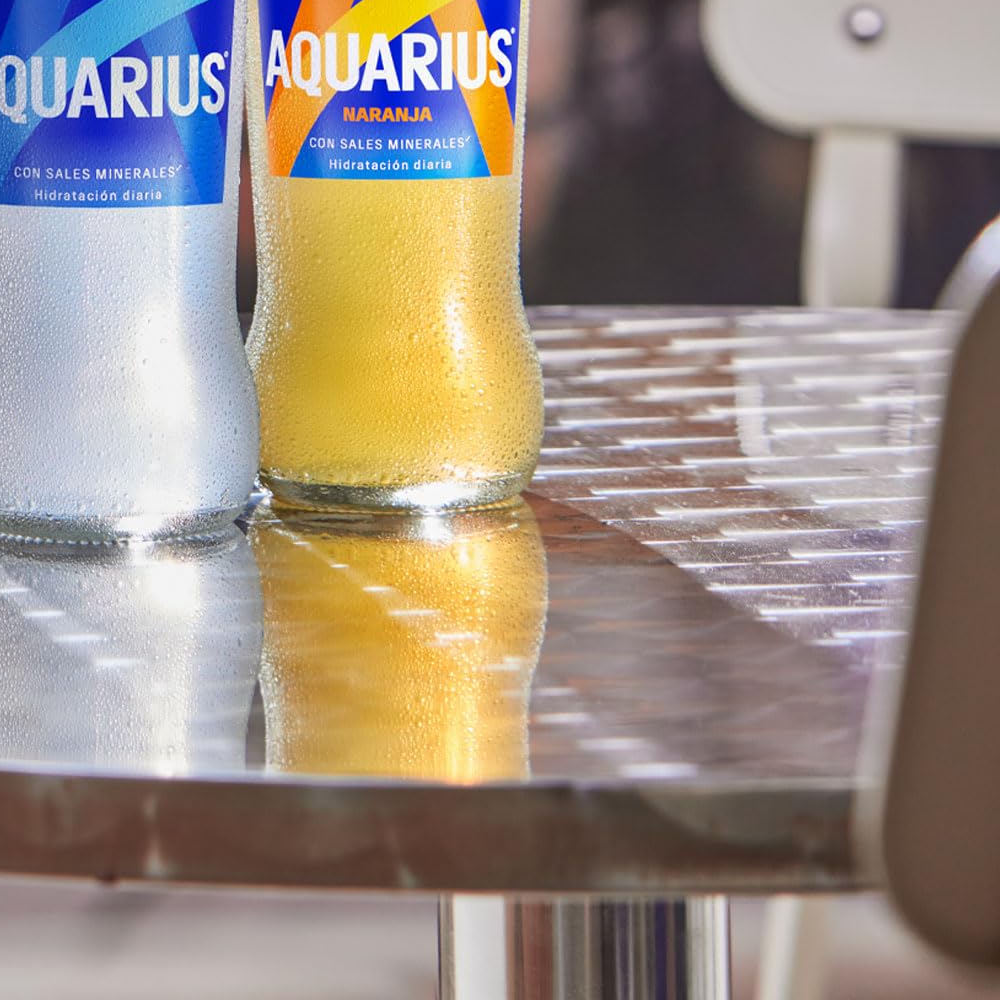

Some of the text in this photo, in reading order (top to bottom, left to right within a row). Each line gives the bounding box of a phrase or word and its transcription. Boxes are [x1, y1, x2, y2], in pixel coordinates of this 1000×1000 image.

[265, 28, 513, 97] AQUARIUS
[343, 106, 433, 122] NARANJA
[309, 137, 466, 150] CON SALES MINERALES
[329, 158, 452, 171] Hidratación diaria
[14, 166, 177, 180] CON SALES MINERALES
[34, 188, 162, 201] Hidratación diaria
